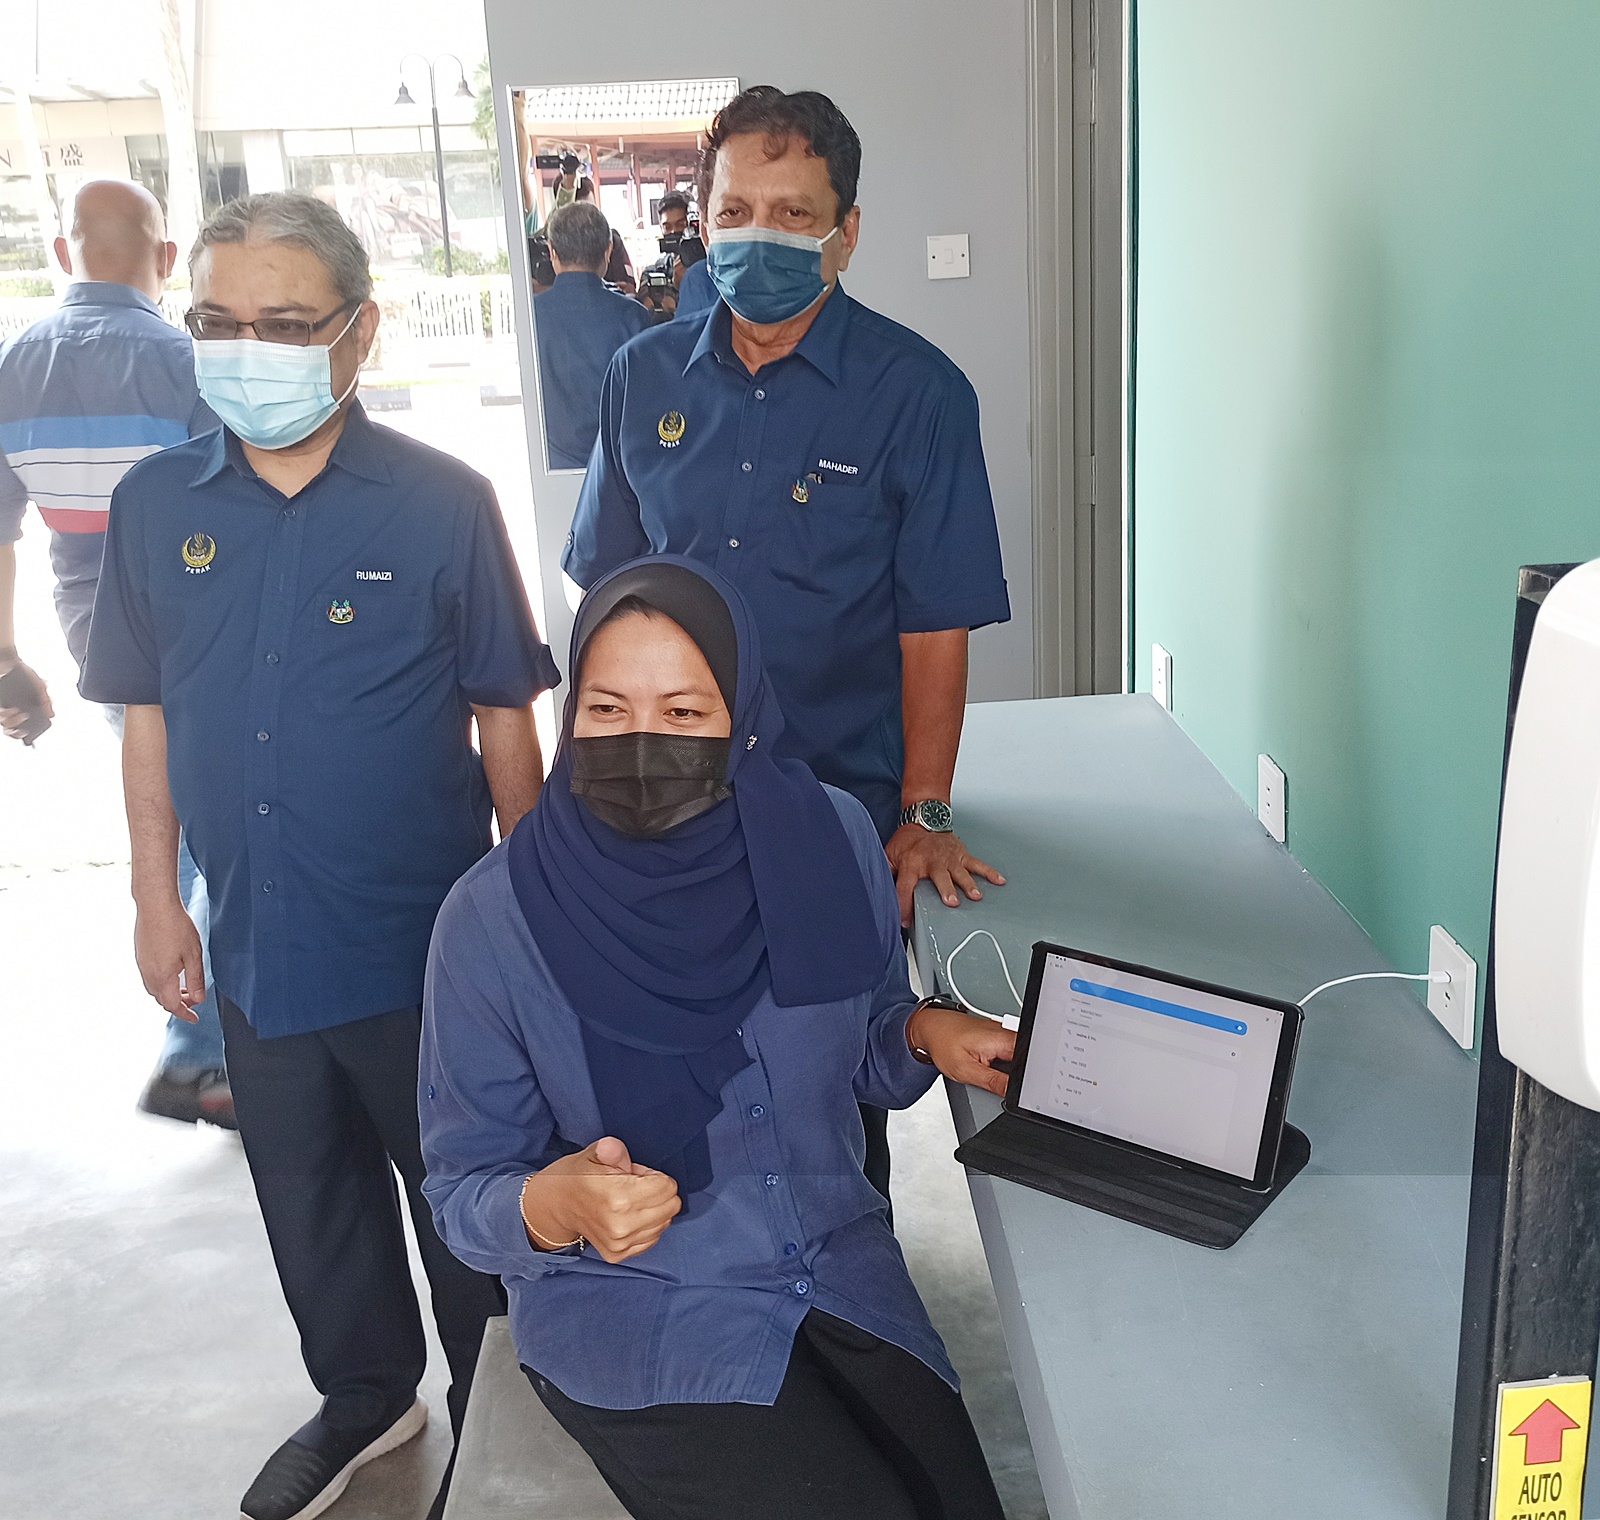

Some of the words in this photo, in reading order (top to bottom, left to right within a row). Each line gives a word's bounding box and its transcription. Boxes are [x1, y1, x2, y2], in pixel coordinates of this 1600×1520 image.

[818, 458, 859, 475] MAHADER
[185, 564, 212, 574] PERAK
[356, 570, 393, 581] RUMAIZI
[1518, 1472, 1562, 1505] AUTO
